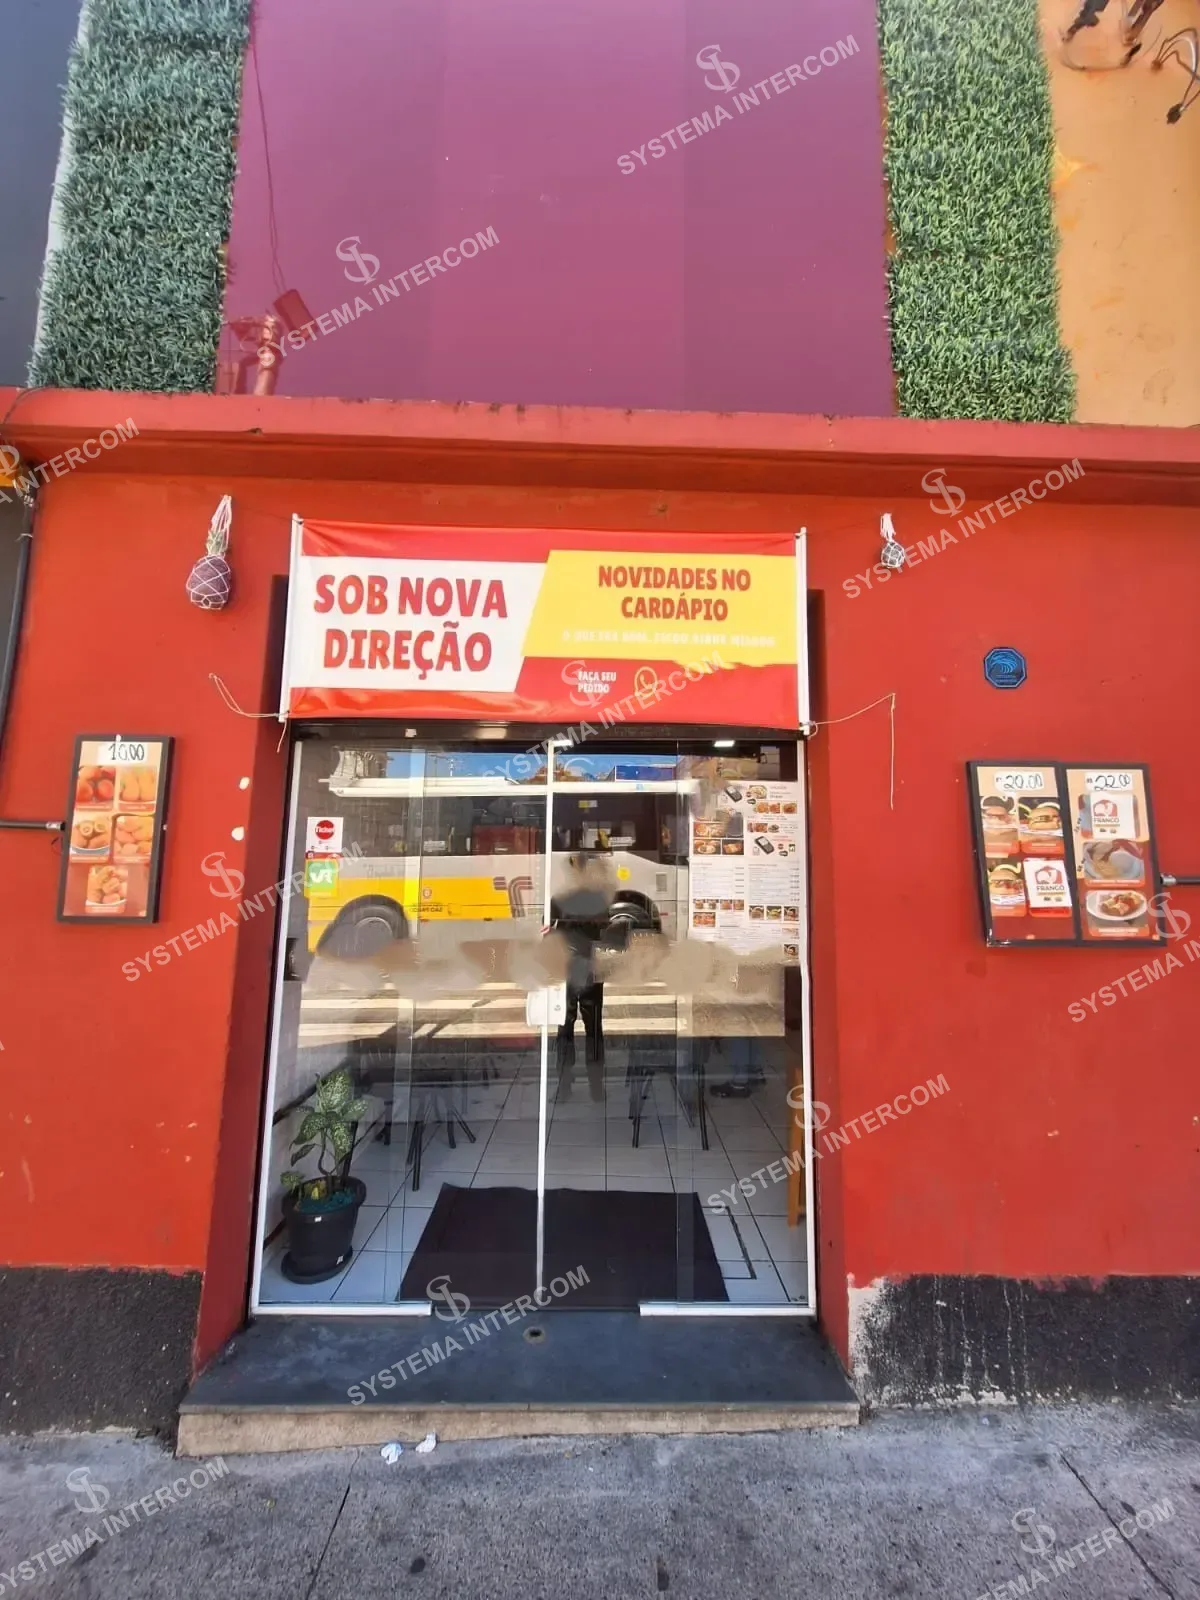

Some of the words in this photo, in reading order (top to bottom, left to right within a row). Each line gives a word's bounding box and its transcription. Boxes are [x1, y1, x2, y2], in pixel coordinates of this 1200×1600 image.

[598, 565, 718, 590] NOVIDADES
[721, 569, 751, 591] NO
[313, 575, 389, 615] SOB
[398, 577, 508, 618] NOVA
[621, 592, 728, 621] CARDÁPIO
[323, 621, 492, 681] DIREÇÃO
